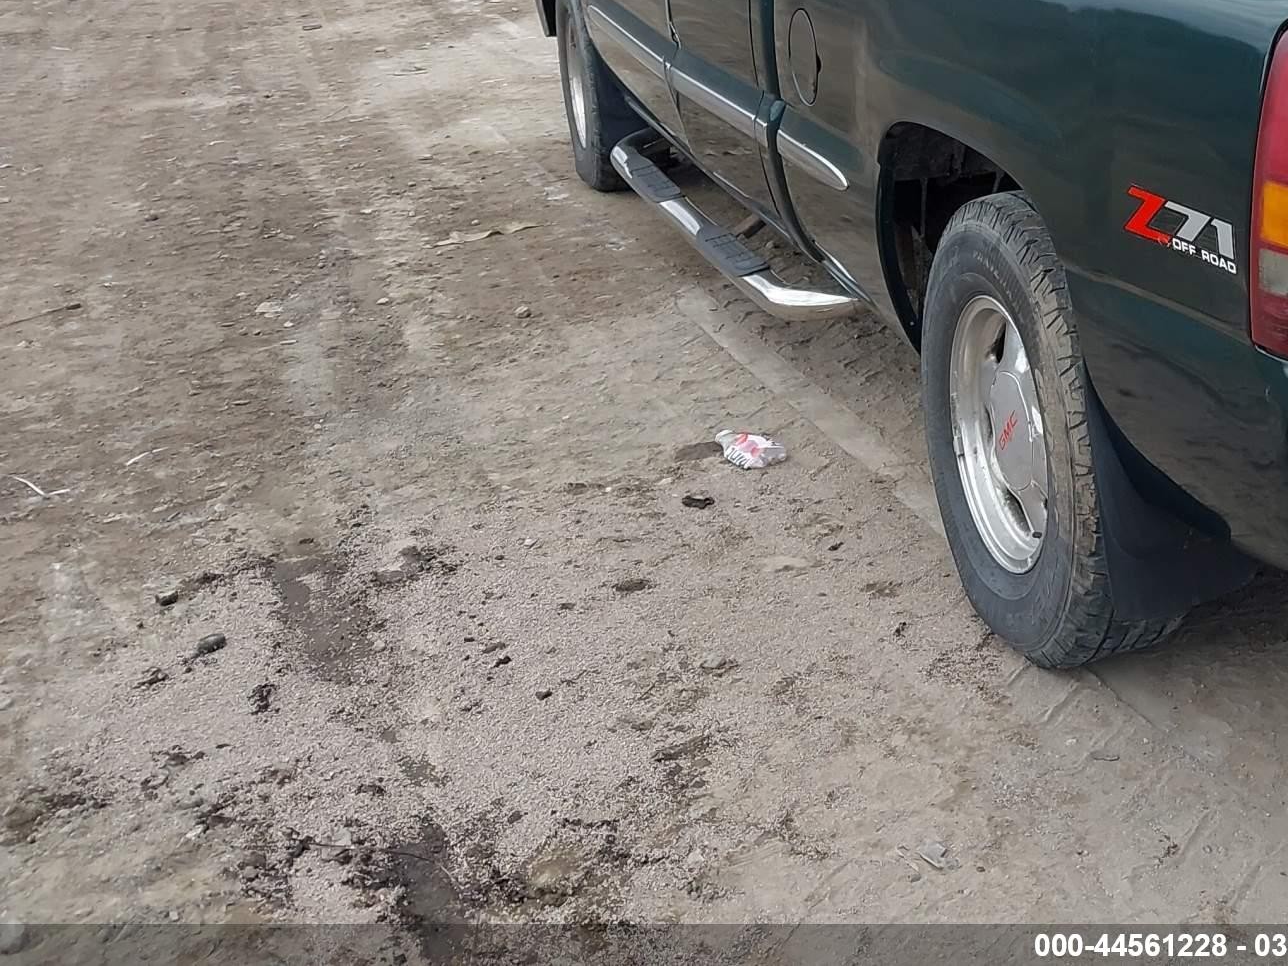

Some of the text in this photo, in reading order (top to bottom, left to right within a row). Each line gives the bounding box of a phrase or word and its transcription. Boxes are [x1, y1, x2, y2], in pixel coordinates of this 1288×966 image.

[1124, 184, 1236, 260] Z71
[1171, 237, 1238, 275] OFF ROAD
[998, 409, 1018, 451] GMC
